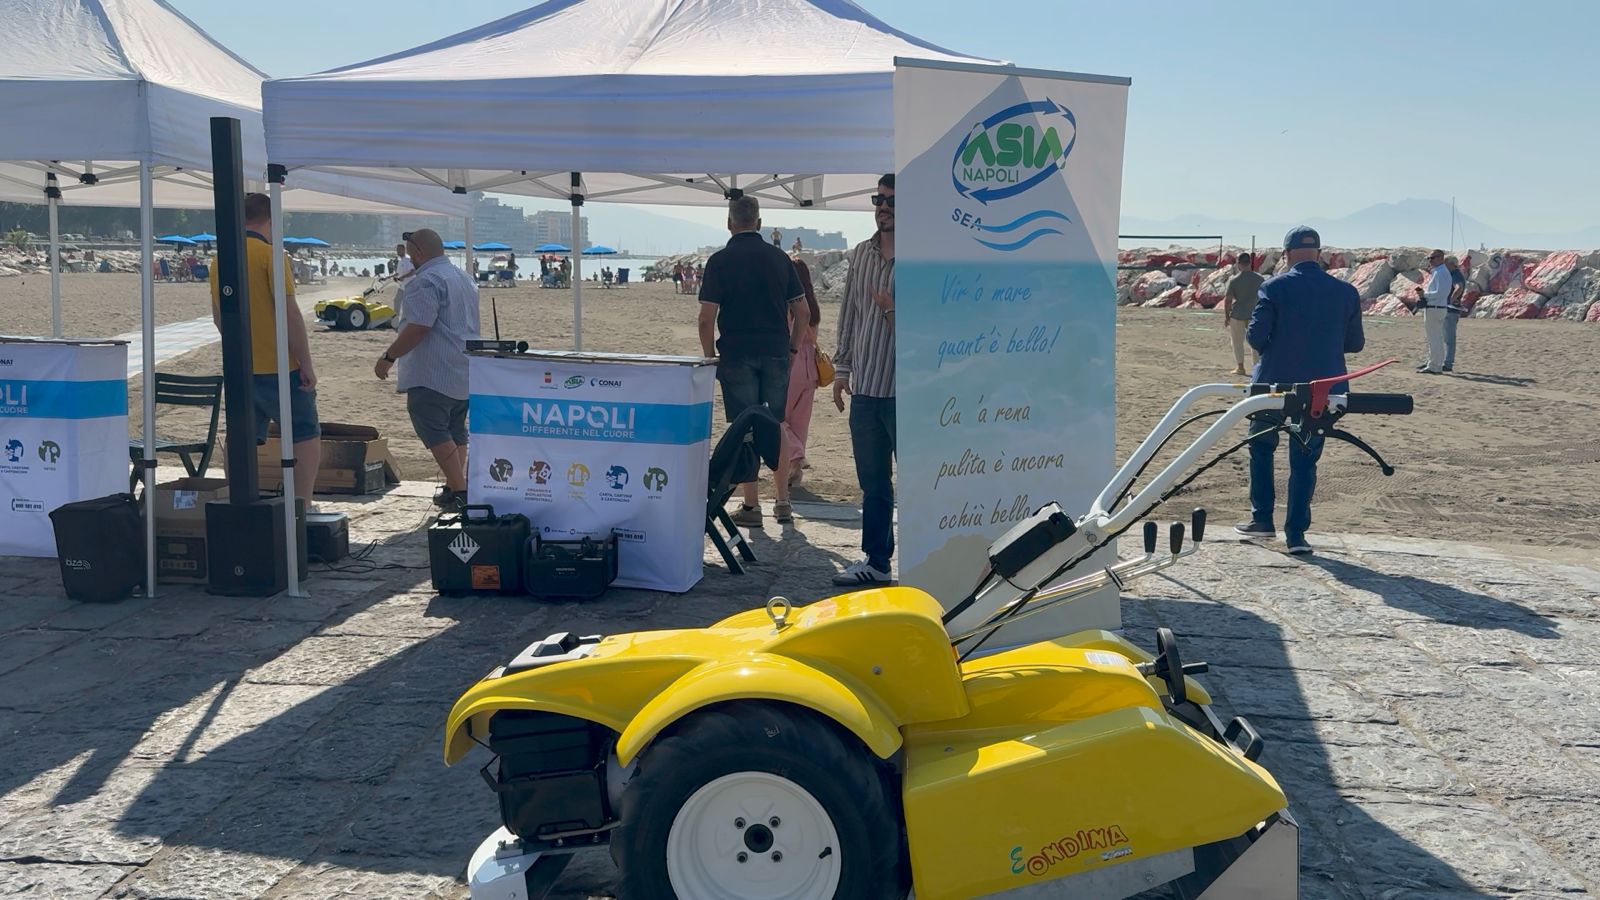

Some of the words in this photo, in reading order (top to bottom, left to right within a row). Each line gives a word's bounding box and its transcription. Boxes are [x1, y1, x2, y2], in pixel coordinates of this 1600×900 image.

[962, 122, 1066, 169] ASIA
[963, 167, 1019, 183] NAPOLI
[951, 208, 982, 231] SEA
[941, 273, 967, 304] Vir
[991, 286, 1032, 302] mare
[1005, 325, 1062, 354] bello!
[599, 379, 622, 387] CONAI
[522, 402, 636, 429] NAPOLI
[939, 396, 961, 428] Cu
[995, 405, 1031, 424] rena
[522, 425, 580, 436] DIFFERENTE
[582, 429, 601, 437] NEL
[603, 430, 635, 439] CUORE
[934, 448, 986, 490] pulita
[1011, 453, 1065, 473] ancora
[939, 501, 985, 530] cchiù
